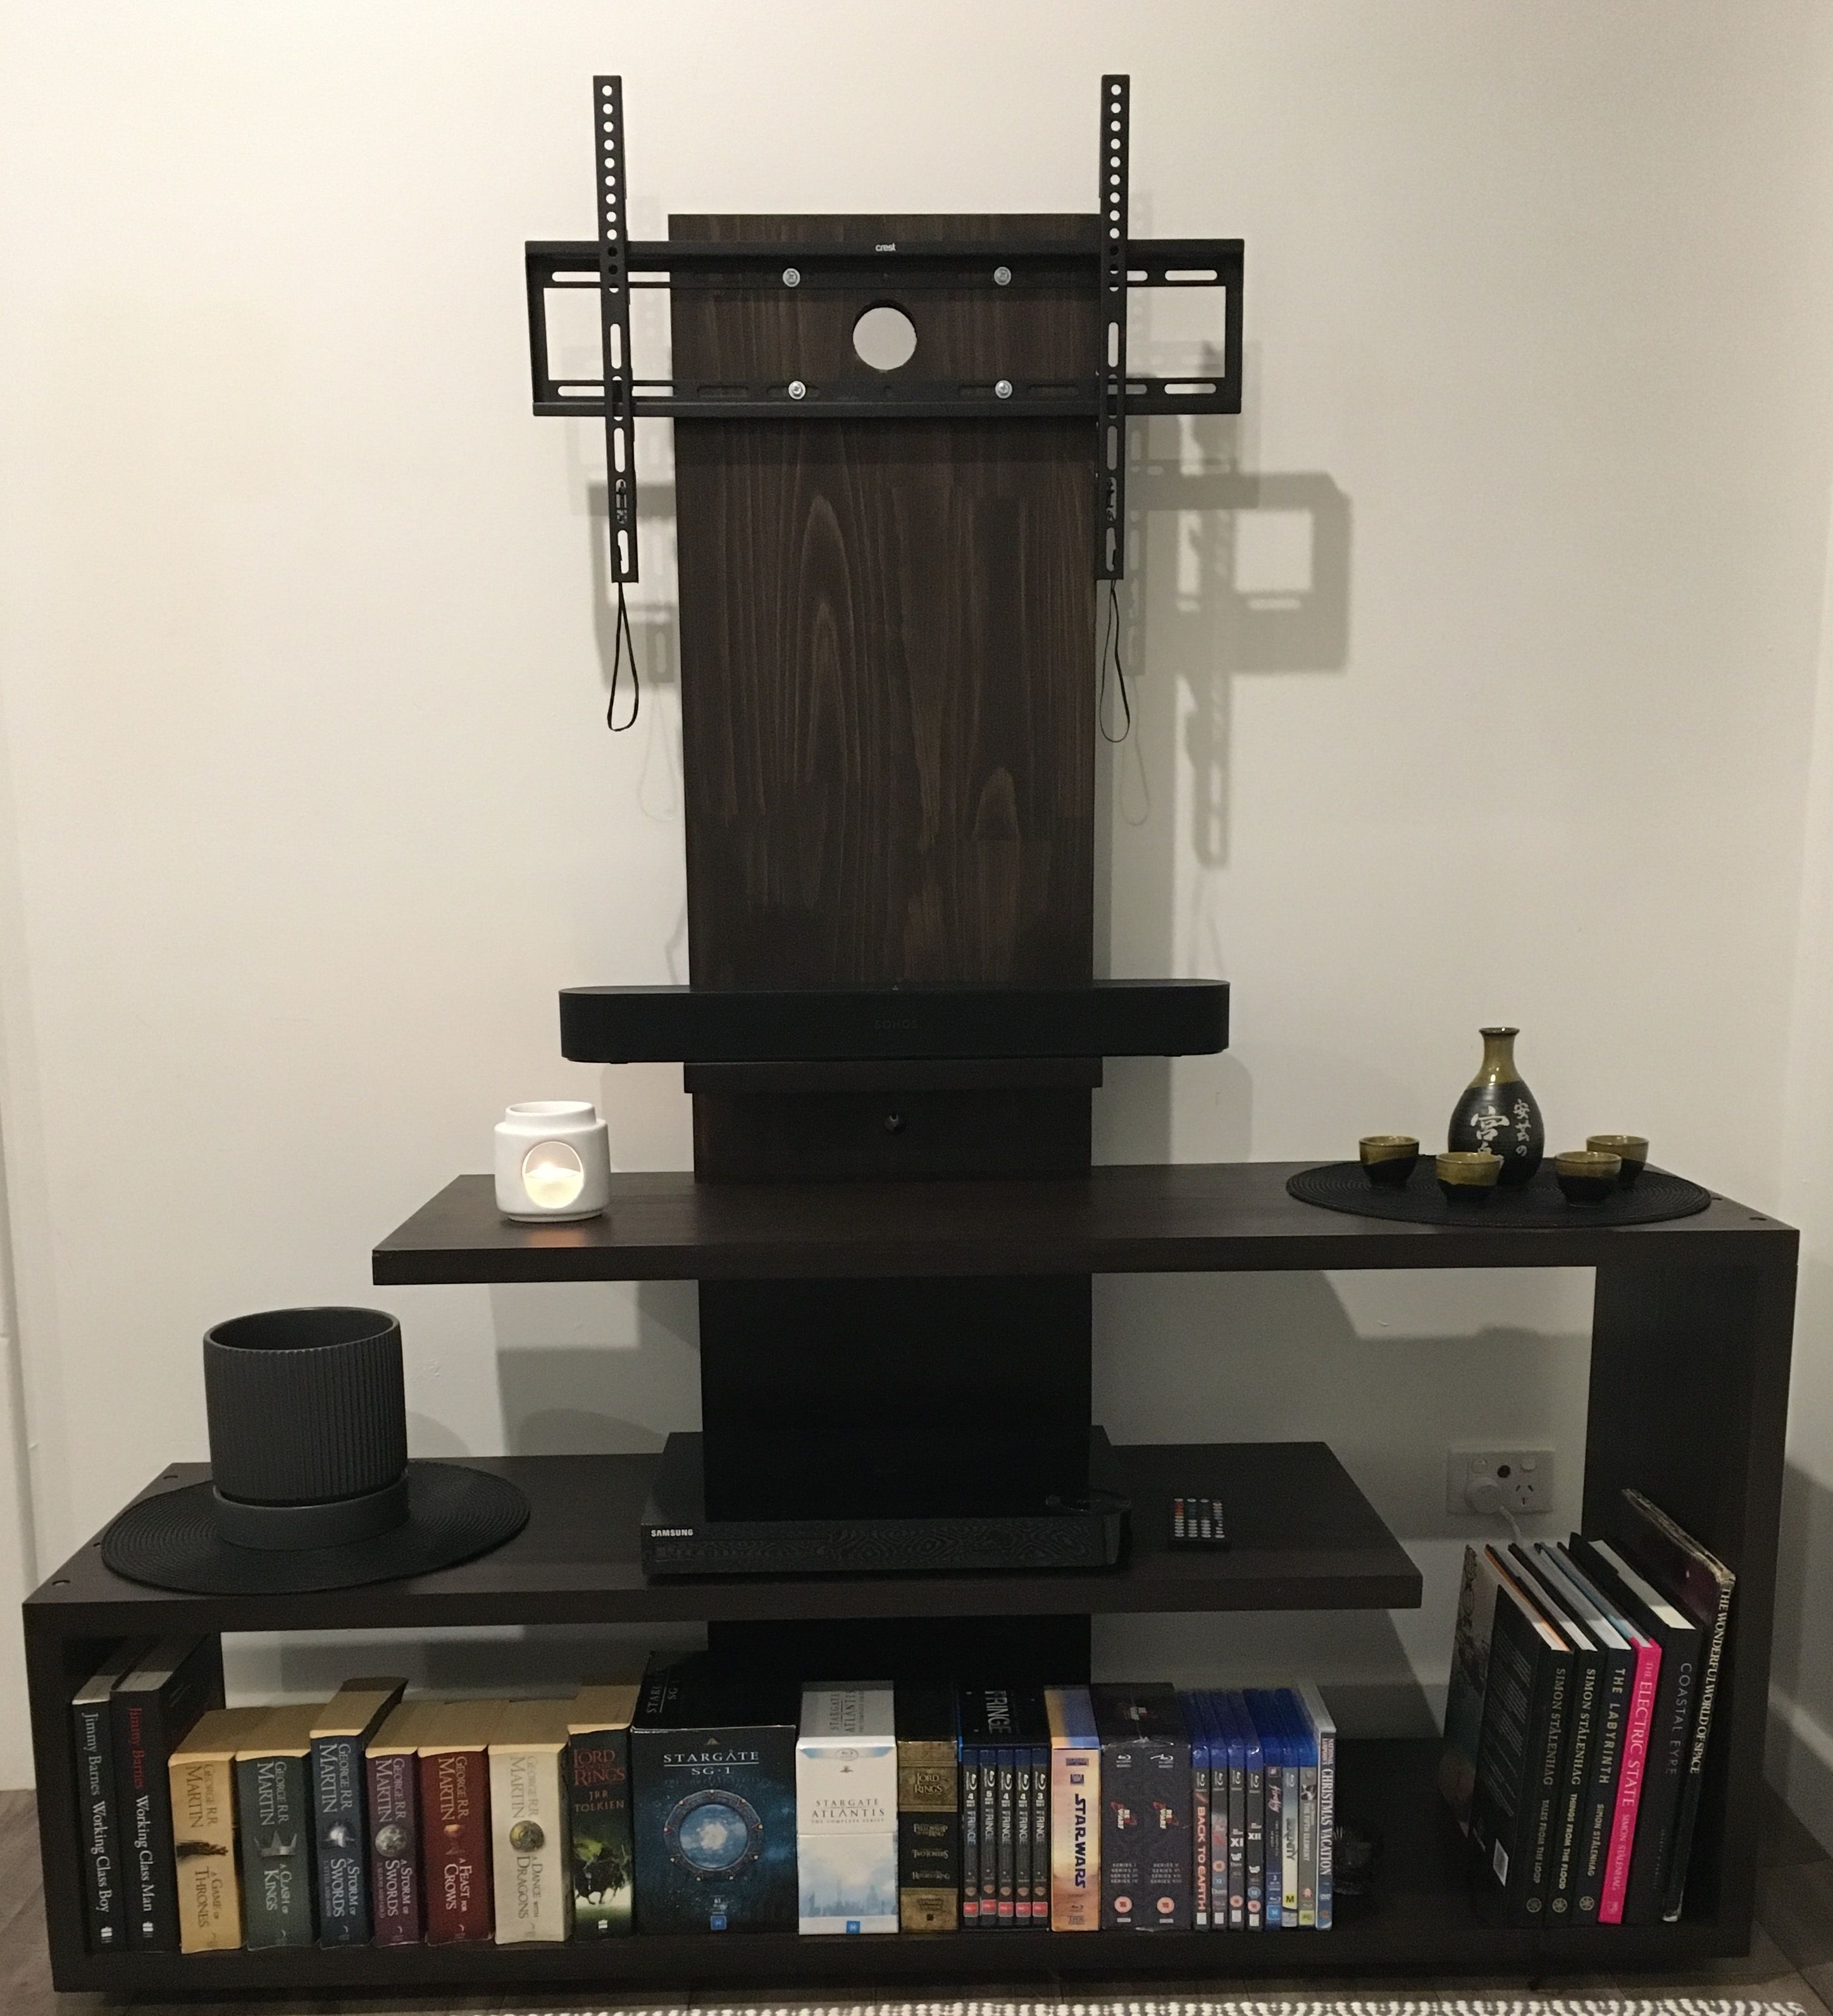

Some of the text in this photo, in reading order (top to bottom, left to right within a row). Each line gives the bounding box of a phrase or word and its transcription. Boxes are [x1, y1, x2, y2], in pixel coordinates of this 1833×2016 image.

[875, 242, 897, 252] crest
[651, 1529, 693, 1537] SAMSUNG
[1552, 1668, 1566, 1710] SIMON
[1690, 1588, 1732, 1775] THE WONDERFUL WORLD OF SPACE
[985, 1690, 1012, 1734] FRINGE
[1570, 1668, 1596, 1786] SIMON STÅLENHAG
[1598, 1668, 1625, 1784] THE LABYRINTH
[1629, 1680, 1653, 1755] ELECTRIC
[1665, 1662, 1693, 1776] COASTAL EYRE
[81, 1712, 101, 1796] Jimmy Barnes
[339, 1744, 351, 1788] GEORGE
[574, 1749, 616, 1769] LORD
[663, 1750, 759, 1764] STARGATE
[186, 1765, 203, 1829] MARTIN
[258, 1762, 275, 1826] MARTIN
[275, 1761, 287, 1802] GEORGE
[319, 1744, 339, 1813] MARTIN
[376, 1759, 392, 1823] MARTIN
[392, 1758, 405, 1802] GEORGE
[438, 1757, 455, 1820] MARTIN
[456, 1756, 467, 1798] GEORGE
[510, 1757, 526, 1819] MARTIN
[574, 1767, 626, 1787] RINGS
[914, 1784, 943, 1793] RINGS
[916, 1772, 940, 1784] LORD
[1622, 1760, 1639, 1807] STATE
[575, 1800, 624, 1813] TOLKIEN
[812, 1808, 885, 1818] ATLANTIS
[816, 1798, 878, 1807] STARGATE
[1320, 1769, 1334, 1876] CHRISTMAS VACATION
[1540, 1799, 1550, 1820] TALES
[1594, 1803, 1605, 1829] SIMON
[967, 1810, 976, 1845] FRINGE
[1002, 1810, 1010, 1844] FRINGE
[1019, 1810, 1028, 1845] FRINGE
[1036, 1810, 1045, 1844] FRINGE
[1075, 1793, 1086, 1888] STAR WARS
[1230, 1838, 1244, 1847] XI
[1537, 1822, 1547, 1845] FROM
[1558, 1793, 1578, 1890] THINGS FROM THE FLOOD
[1620, 1814, 1631, 1841] SIMON
[90, 1800, 112, 1912] Working Class Boy
[134, 1795, 155, 1912] Working Class Man
[1197, 1806, 1206, 1910] BACK TO EARTH
[1533, 1862, 1543, 1884] LOOP
[194, 1865, 209, 1928] THRONES
[264, 1868, 278, 1912] KINGS
[280, 1870, 291, 1905] CLASH
[331, 1858, 347, 1918] SWORDS
[347, 1866, 360, 1909] STORM
[385, 1860, 400, 1917] SWORDS
[401, 1866, 413, 1908] STORM
[444, 1864, 458, 1911] CROWS
[459, 1865, 472, 1899] FEAST
[517, 1856, 530, 1919] DRAGONS
[531, 1863, 543, 1898] DANCE
